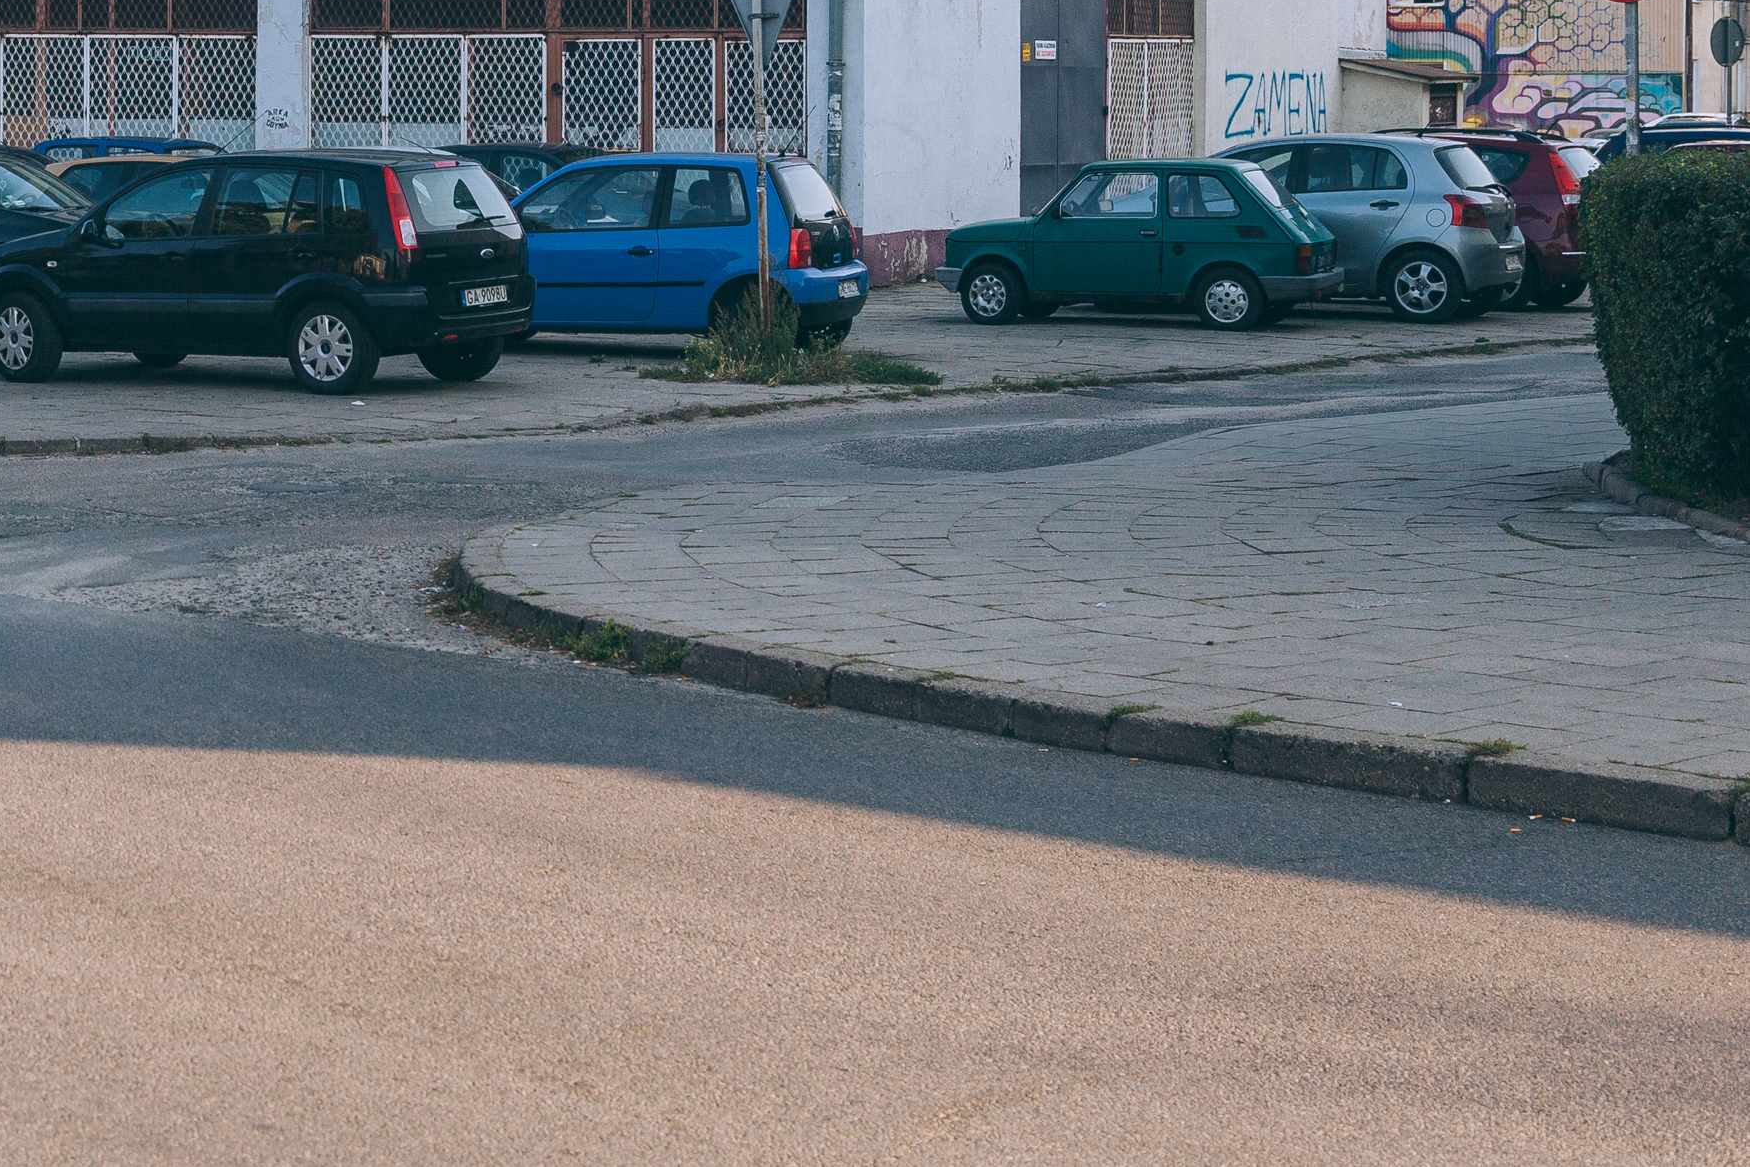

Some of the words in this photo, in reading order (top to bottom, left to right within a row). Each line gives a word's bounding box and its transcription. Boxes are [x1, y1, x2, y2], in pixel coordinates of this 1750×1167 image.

[268, 108, 289, 119] ARKA
[1224, 68, 1328, 139] ZAMENA
[466, 289, 480, 305] GA
[481, 285, 507, 303] 9098U
